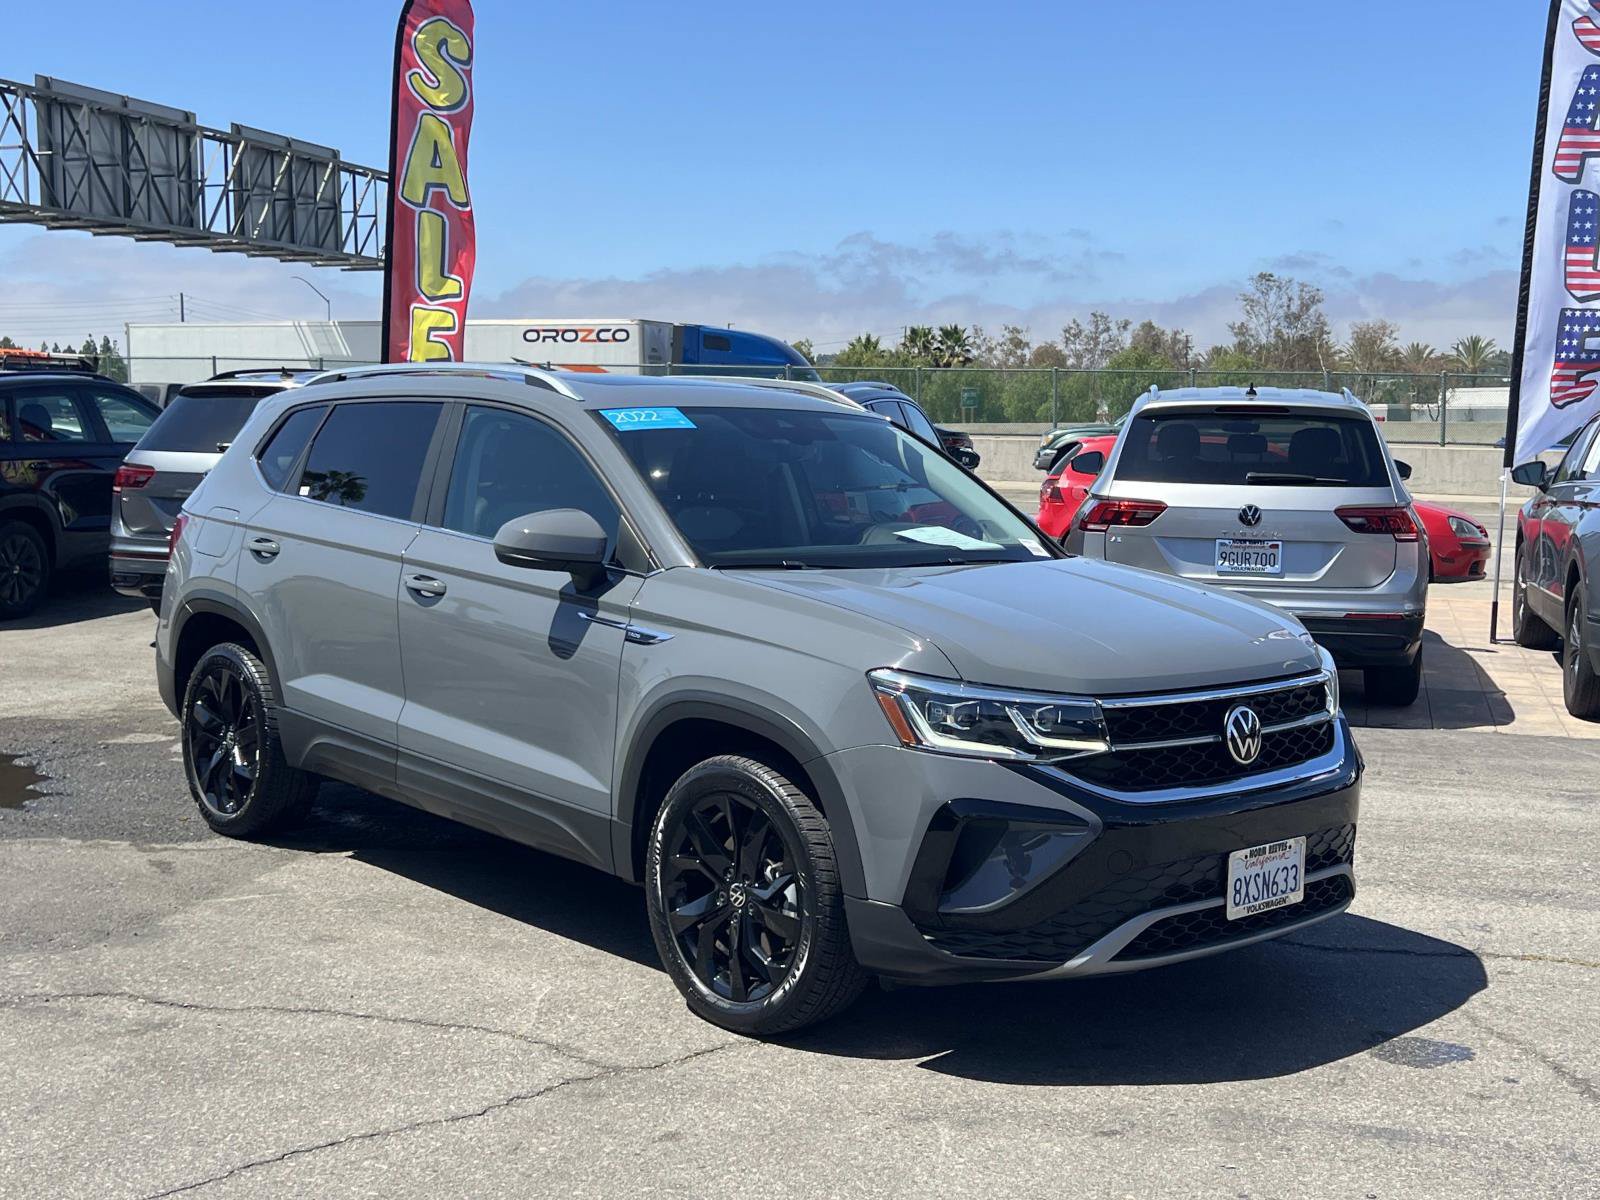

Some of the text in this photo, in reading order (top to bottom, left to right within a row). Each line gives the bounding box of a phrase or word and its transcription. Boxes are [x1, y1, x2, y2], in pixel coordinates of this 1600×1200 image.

[399, 17, 473, 362] SALE
[523, 328, 630, 343] OROZCO
[607, 410, 662, 424] 2022
[1219, 551, 1276, 567] 9GUR700
[1233, 863, 1299, 907] 8XSN633
